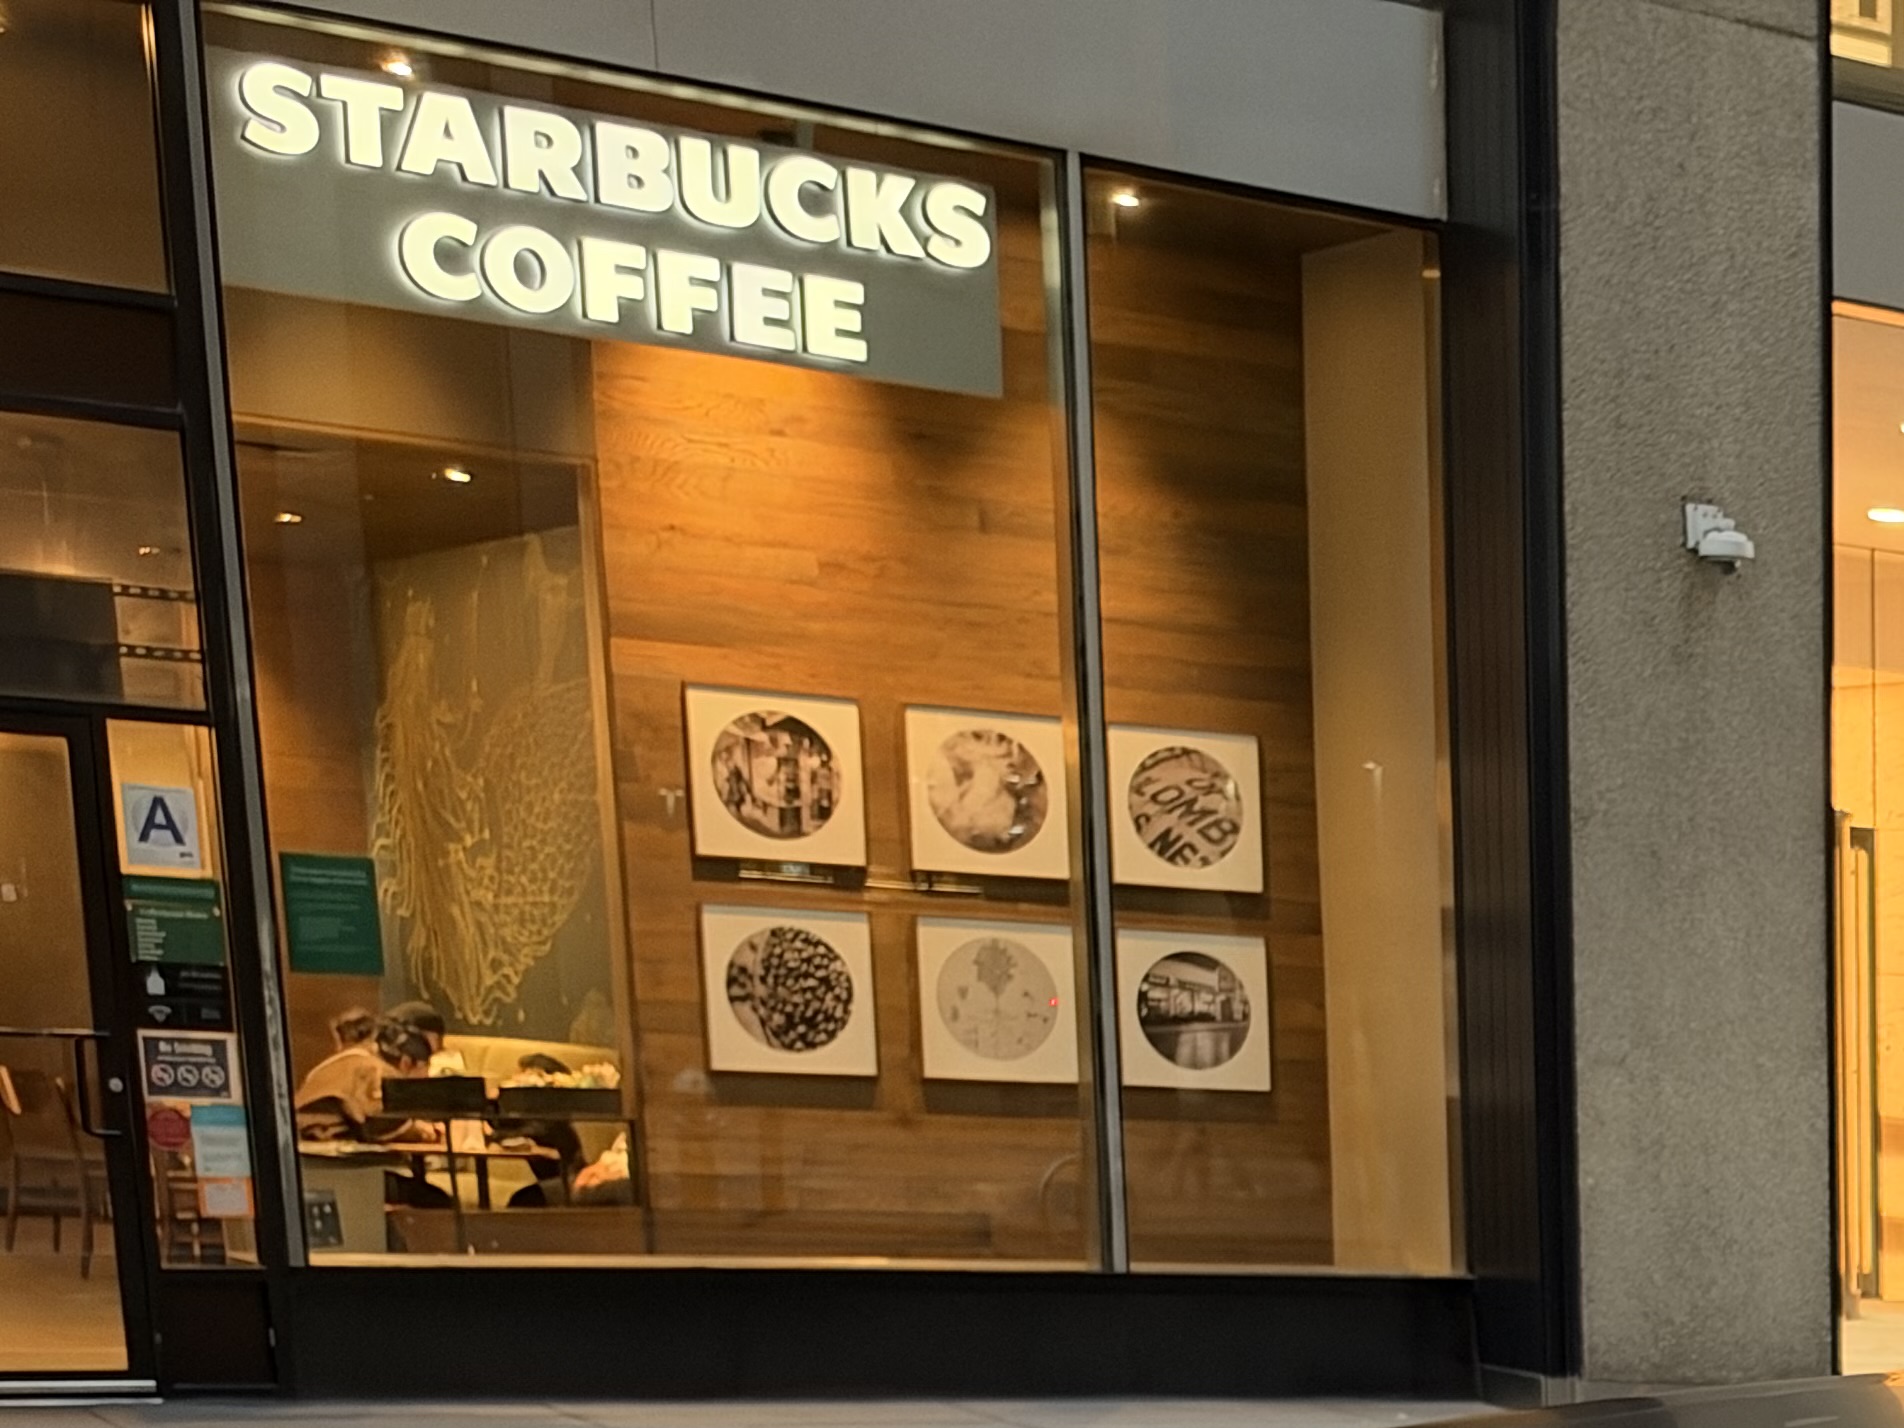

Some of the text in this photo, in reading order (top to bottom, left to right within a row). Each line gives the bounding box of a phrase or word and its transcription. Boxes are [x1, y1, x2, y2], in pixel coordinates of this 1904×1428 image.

[238, 61, 993, 269] STARBUCKS
[398, 211, 868, 362] COFFEE
[138, 795, 186, 846] A
